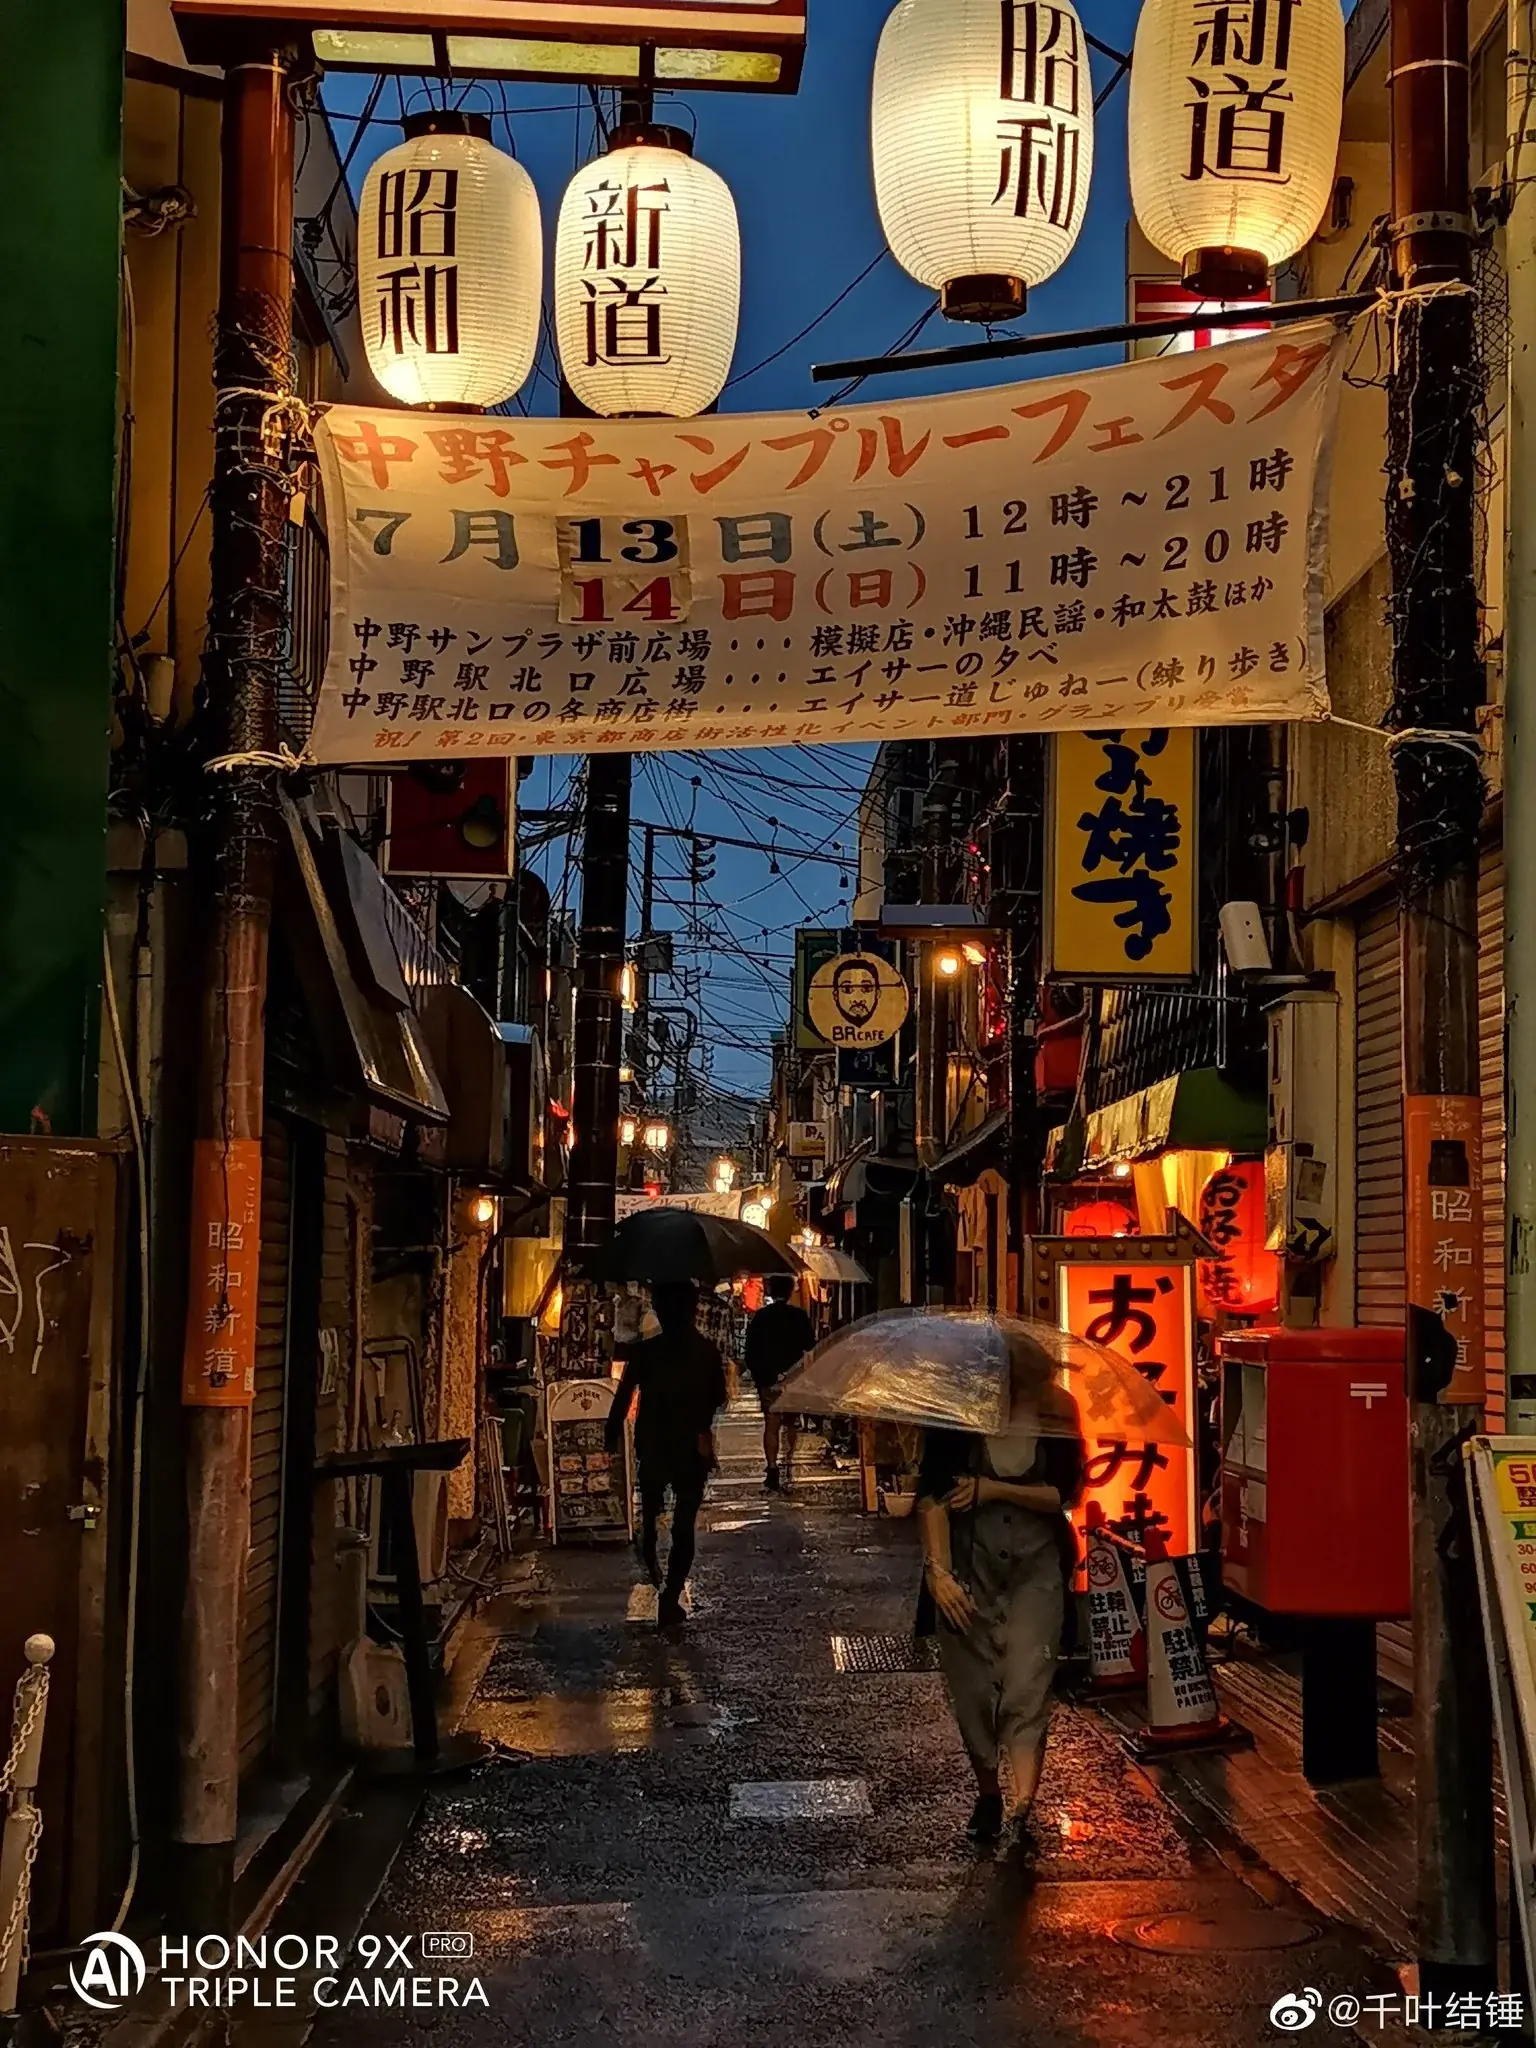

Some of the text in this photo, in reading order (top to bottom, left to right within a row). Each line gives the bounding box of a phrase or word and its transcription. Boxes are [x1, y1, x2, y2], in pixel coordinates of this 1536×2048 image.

[990, 1, 1080, 230] 昭和
[1180, 0, 1295, 185] 新道
[376, 168, 460, 355] 昭和
[579, 177, 672, 367] 新道
[330, 342, 1332, 498] 中野チャンプルーフェスタ
[1071, 730, 1182, 961] み焼き
